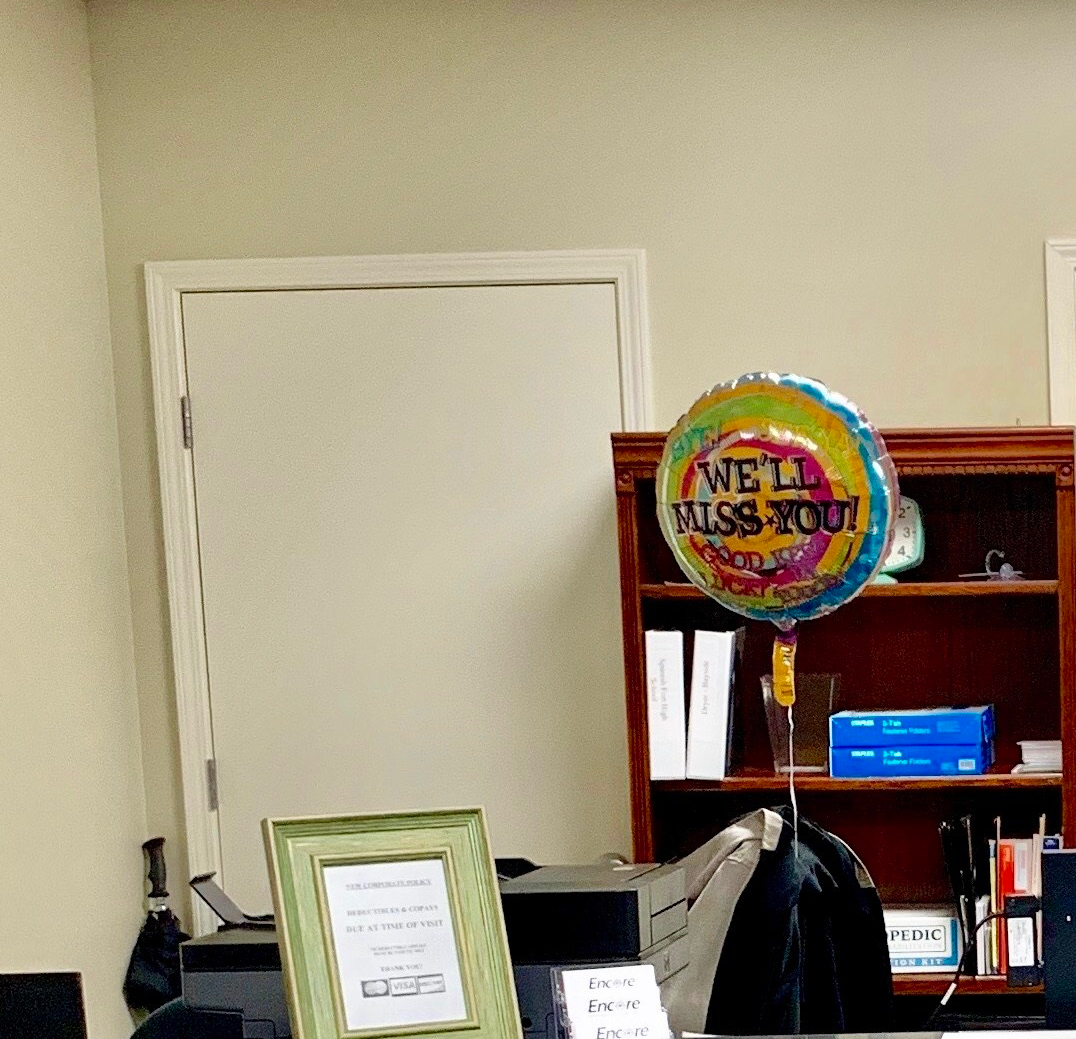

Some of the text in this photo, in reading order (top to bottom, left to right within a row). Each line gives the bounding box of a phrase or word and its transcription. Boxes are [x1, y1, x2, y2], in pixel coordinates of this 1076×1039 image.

[697, 453, 821, 494] WE'LL
[672, 495, 860, 538] MISS YOU!
[898, 508, 906, 518] 2
[903, 527, 911, 538] 3
[897, 546, 906, 556] 4
[367, 924, 378, 932] AT
[380, 922, 403, 931] TIME
[406, 921, 418, 929] OF
[420, 919, 443, 927] VISIT
[887, 929, 942, 942] PEDIC
[922, 958, 943, 966] KIT
